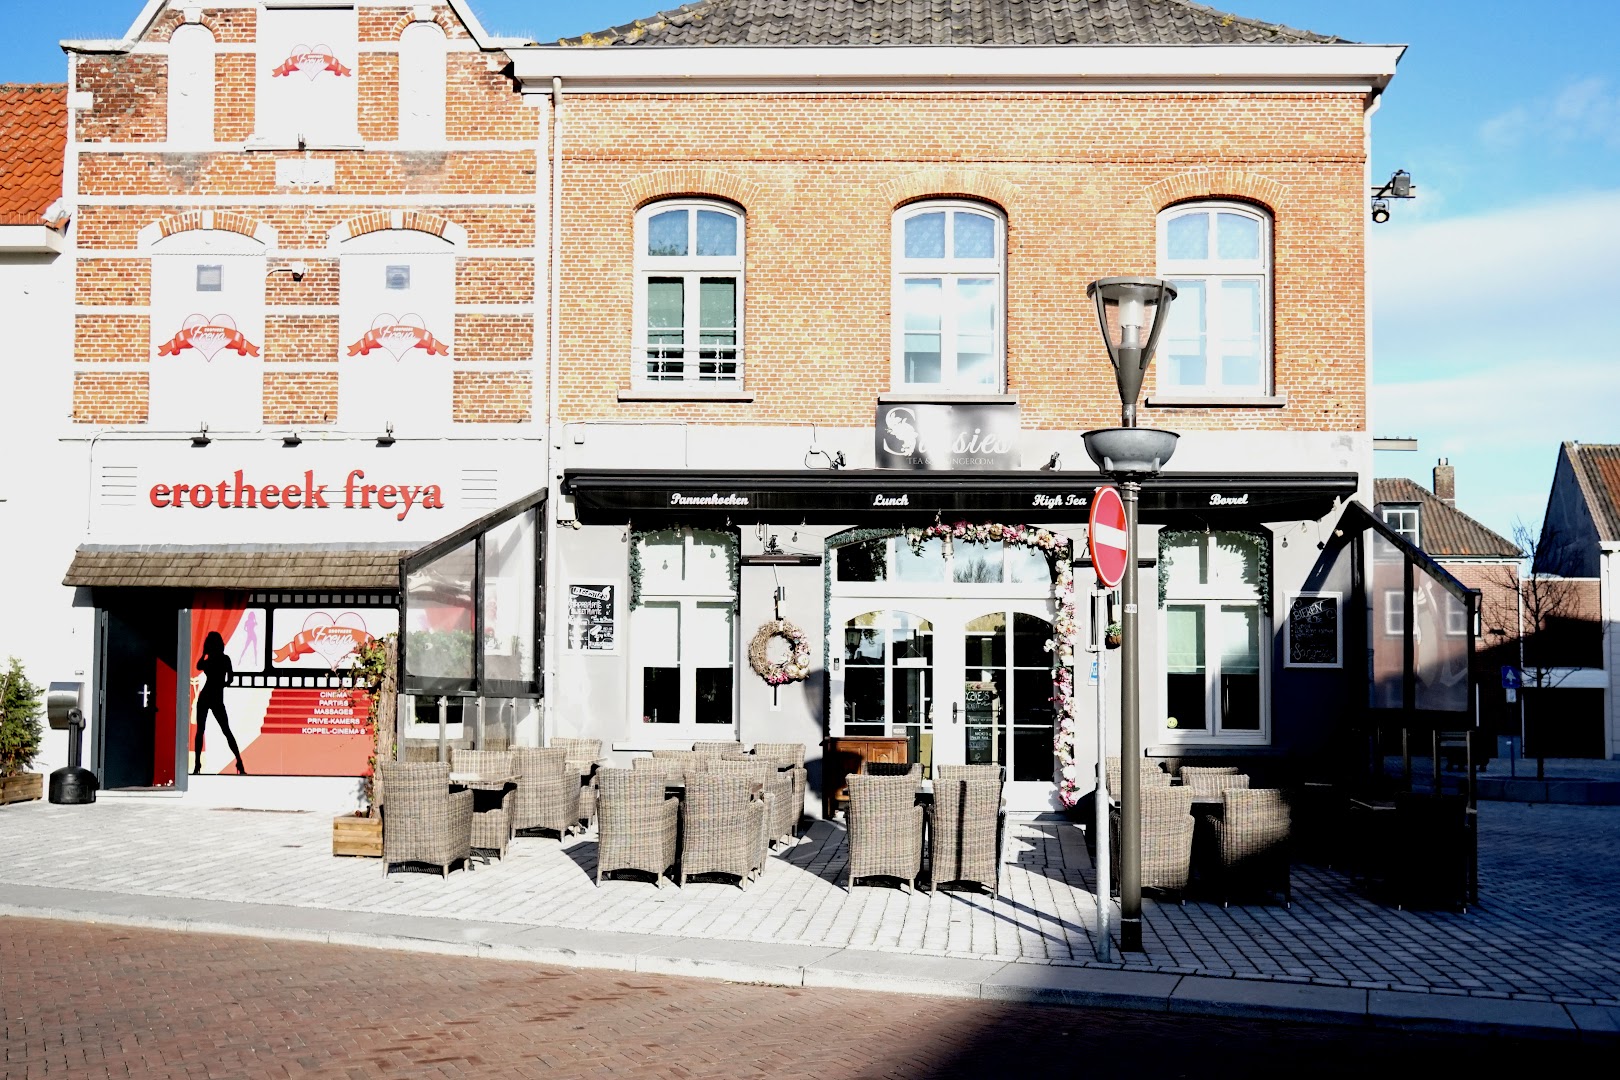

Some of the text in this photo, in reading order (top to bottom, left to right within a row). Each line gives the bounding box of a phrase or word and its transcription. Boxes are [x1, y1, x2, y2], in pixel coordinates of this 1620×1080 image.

[190, 324, 228, 343] Freya
[379, 324, 417, 341] Freya
[883, 407, 1012, 457] Ssies
[906, 457, 923, 465] TEA
[150, 469, 445, 521] erotheek freya
[670, 492, 750, 506] Pannenkoeken
[872, 494, 909, 506] Lunch
[1032, 494, 1087, 509] High Tea
[1209, 493, 1249, 506] Borrel
[311, 625, 356, 646] Freya
[319, 699, 349, 707] PARTIES
[313, 708, 354, 716] MASSAGES
[307, 717, 361, 725] PRIVE-KAMERS
